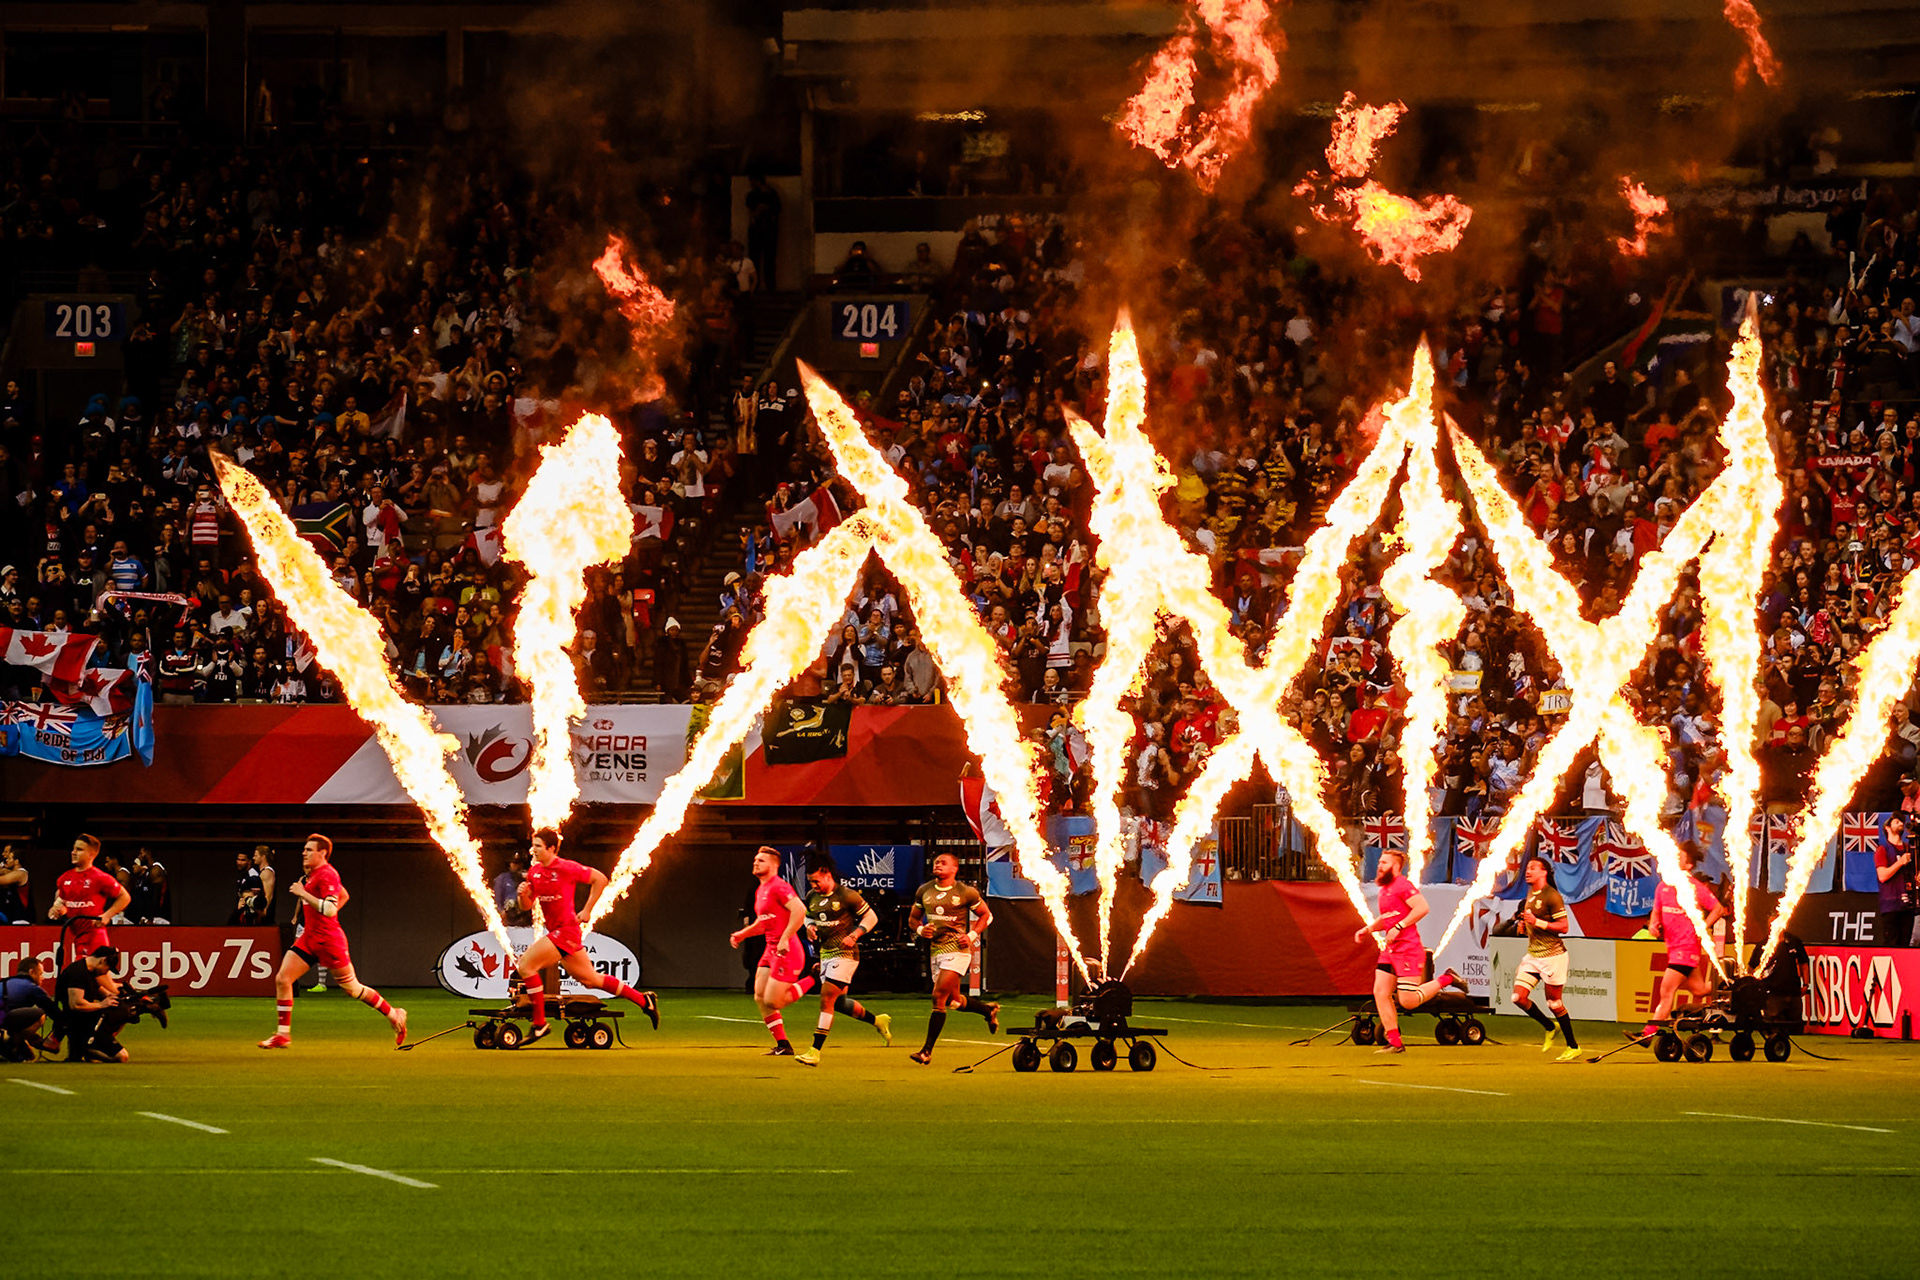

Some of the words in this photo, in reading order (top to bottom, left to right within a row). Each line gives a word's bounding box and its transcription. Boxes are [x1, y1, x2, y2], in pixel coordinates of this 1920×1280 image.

[56, 304, 111, 337] 203
[842, 304, 898, 338] 204
[1818, 456, 1871, 466] CANADA
[36, 730, 71, 748] PRIDE
[575, 735, 646, 751] NADA
[61, 749, 77, 762] OF
[83, 747, 106, 762] FIJI
[574, 753, 646, 769] VENS
[1609, 878, 1640, 914] Fiji
[1829, 912, 1876, 940] THE
[0, 942, 60, 979] rld
[73, 942, 220, 990] ugby
[223, 939, 272, 979] 7s
[1462, 962, 1488, 976] HSBC
[1801, 955, 1863, 1024] HSBC
